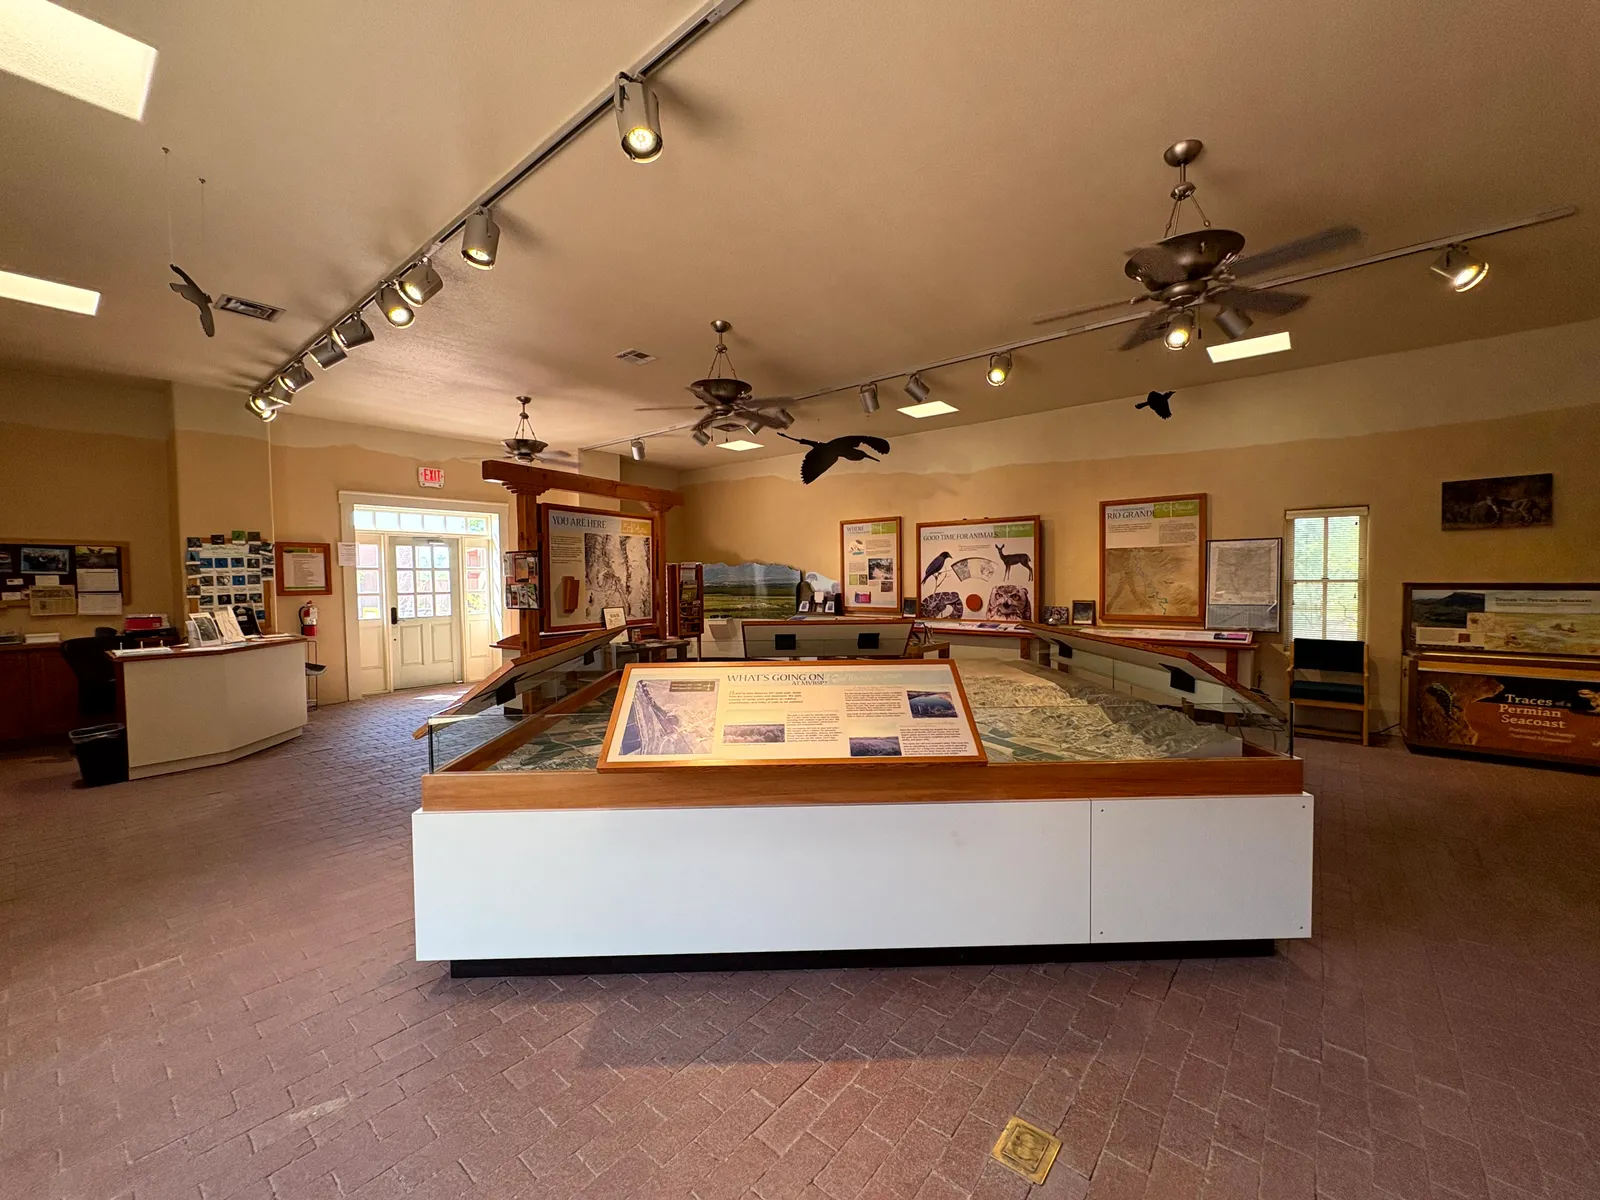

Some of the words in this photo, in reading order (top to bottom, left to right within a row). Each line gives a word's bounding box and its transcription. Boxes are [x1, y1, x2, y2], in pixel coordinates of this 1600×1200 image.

[424, 468, 441, 482] EXIT
[552, 515, 569, 526] YOU
[570, 516, 587, 528] ARE
[587, 519, 607, 529] HERE
[1107, 511, 1121, 520] RIO
[923, 533, 940, 541] GOOD
[941, 533, 956, 541] TIME
[956, 532, 968, 540] FOR
[968, 531, 999, 539] ANIMALS
[727, 673, 770, 682] WHAT'S
[771, 673, 807, 682] GOING
[808, 673, 825, 681] ON
[1504, 693, 1553, 707] Traces
[1499, 703, 1562, 718] Permian
[1501, 714, 1567, 729] Seacoast
